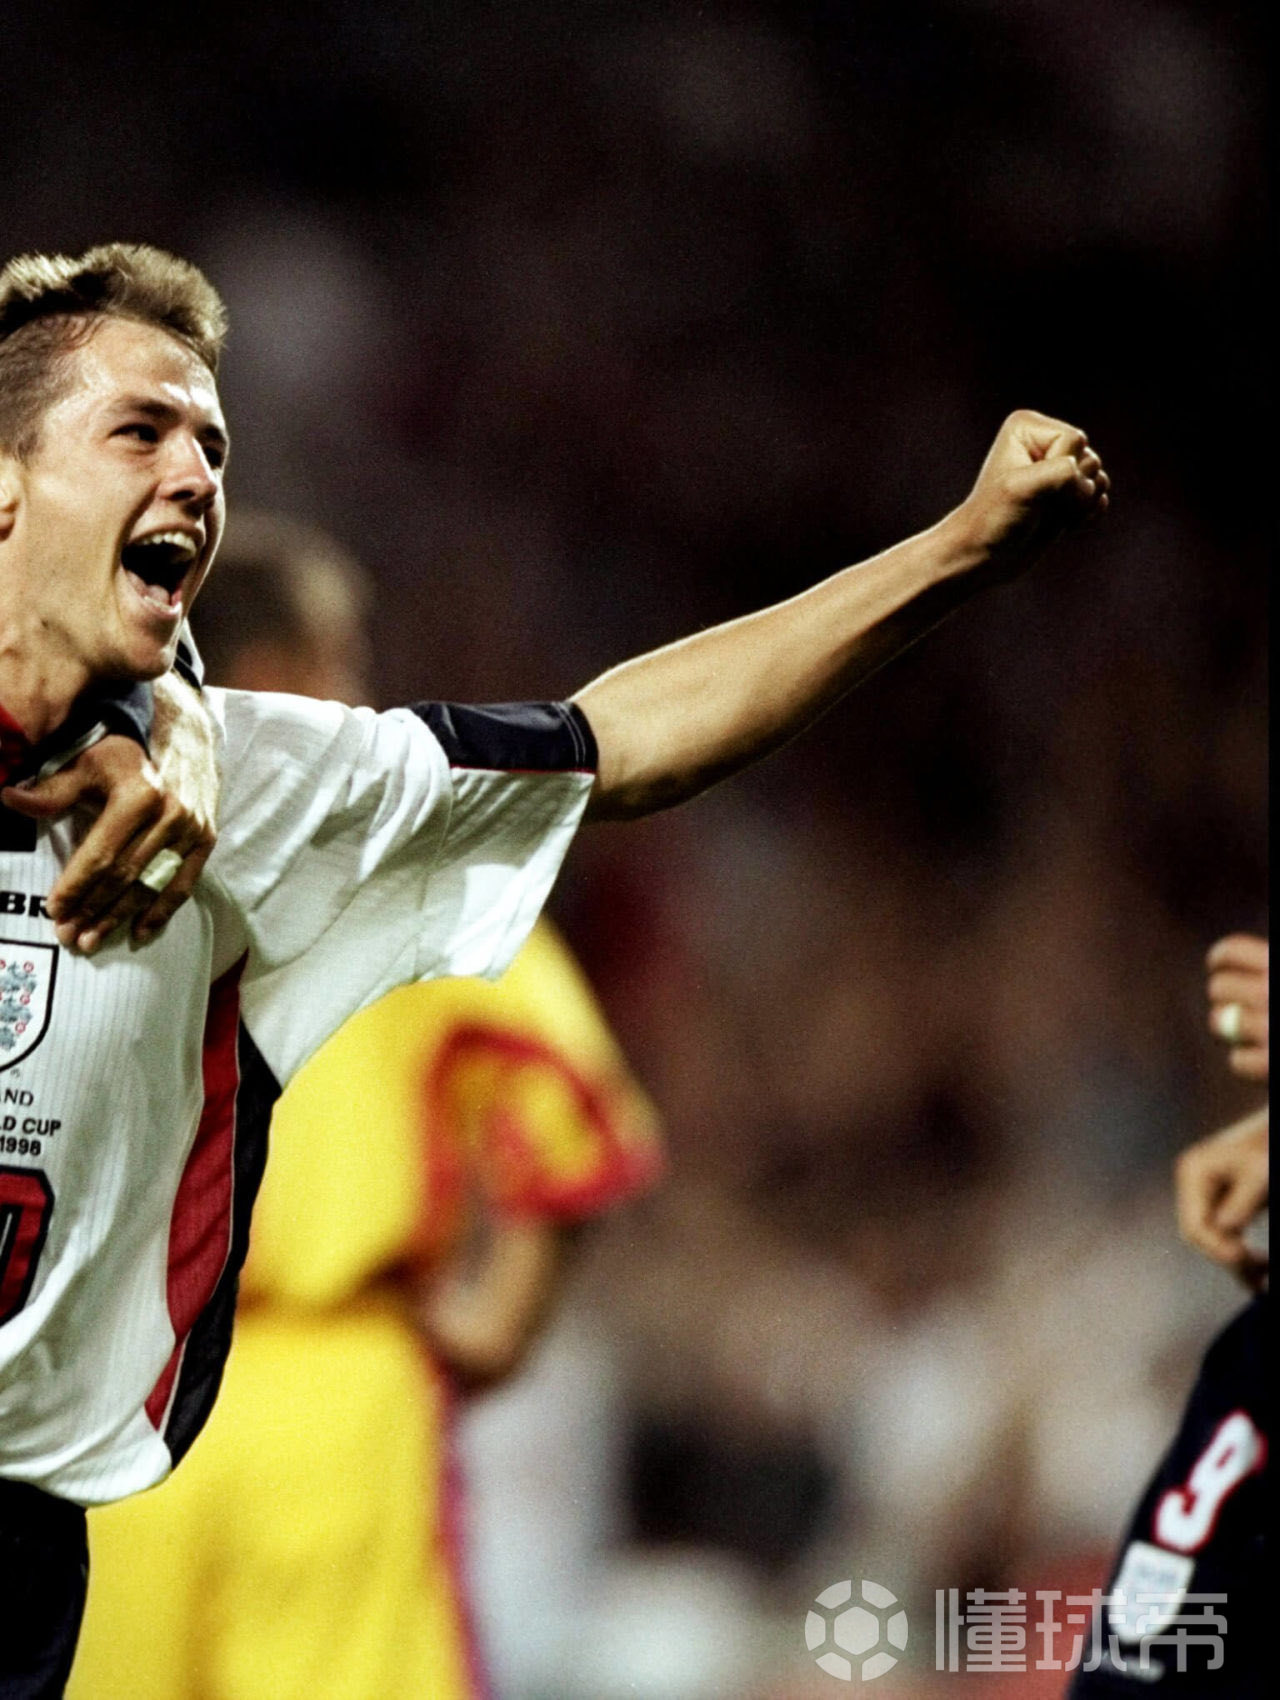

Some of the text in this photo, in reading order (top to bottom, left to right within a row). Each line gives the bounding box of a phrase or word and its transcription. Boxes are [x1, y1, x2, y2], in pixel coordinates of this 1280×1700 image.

[22, 1117, 61, 1137] CUP
[0, 1134, 42, 1156] 1998
[1151, 1408, 1270, 1556] 9
